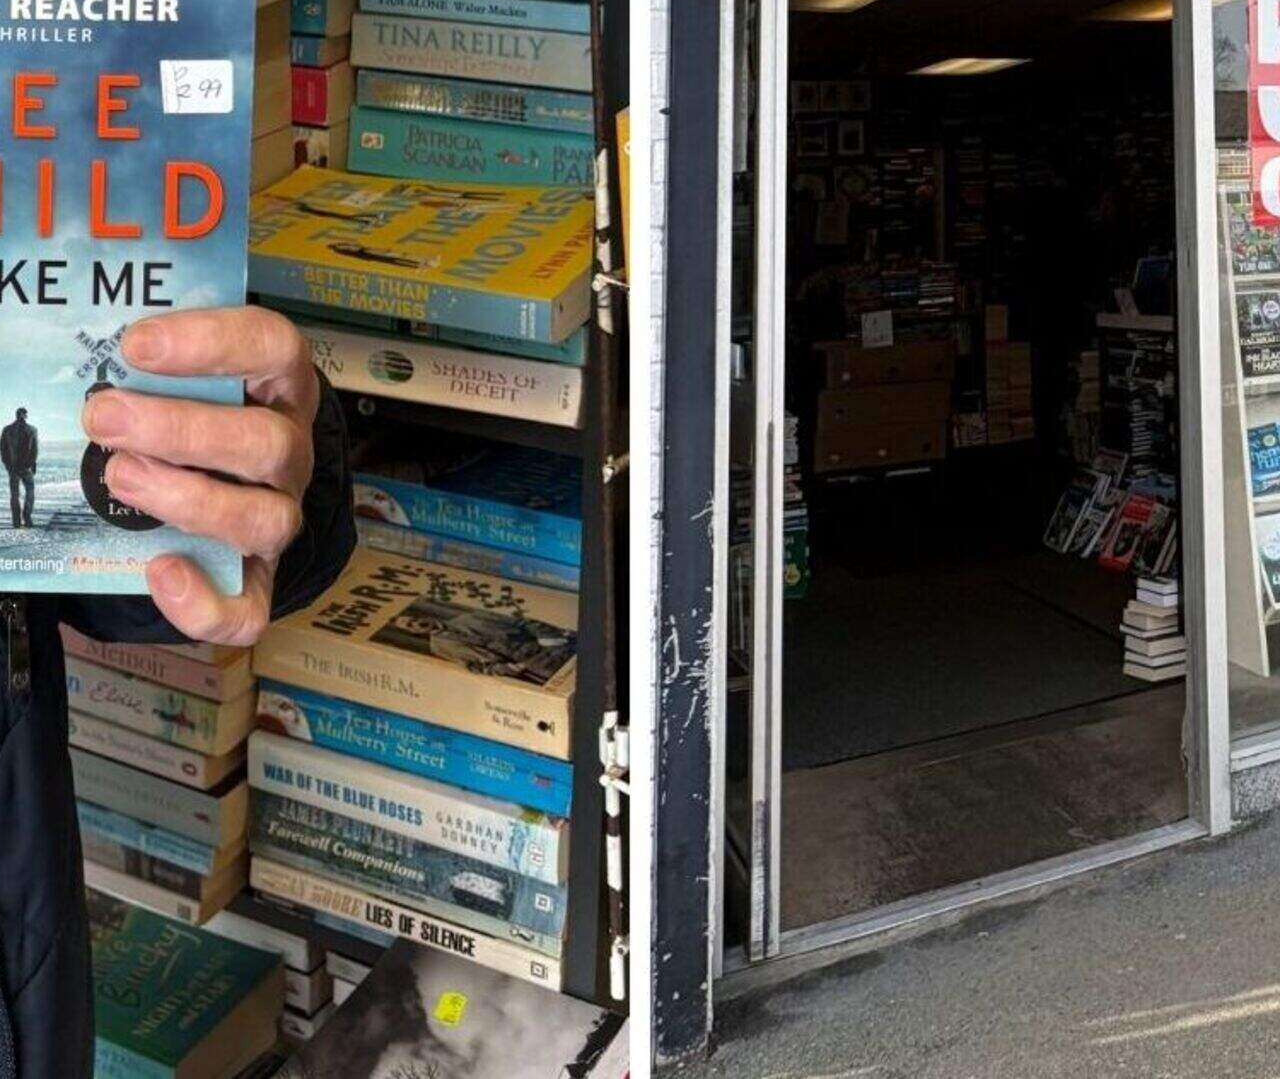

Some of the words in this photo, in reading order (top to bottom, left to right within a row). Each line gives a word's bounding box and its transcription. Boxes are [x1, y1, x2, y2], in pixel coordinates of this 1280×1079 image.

[373, 22, 440, 47] TINA
[450, 30, 549, 62] REILLY
[92, 261, 173, 307] ME
[379, 277, 431, 300] THAN
[351, 291, 426, 319] MOVIES
[431, 359, 508, 385] SHADES
[449, 379, 521, 404] DECEIT
[263, 762, 294, 783] WAR
[296, 770, 314, 792] OF
[315, 778, 341, 800] THE
[343, 784, 377, 811] BLUE
[378, 796, 423, 827] ROSES
[364, 901, 394, 928] LIES
[398, 911, 415, 933] OF
[419, 920, 476, 958] SILENCE
